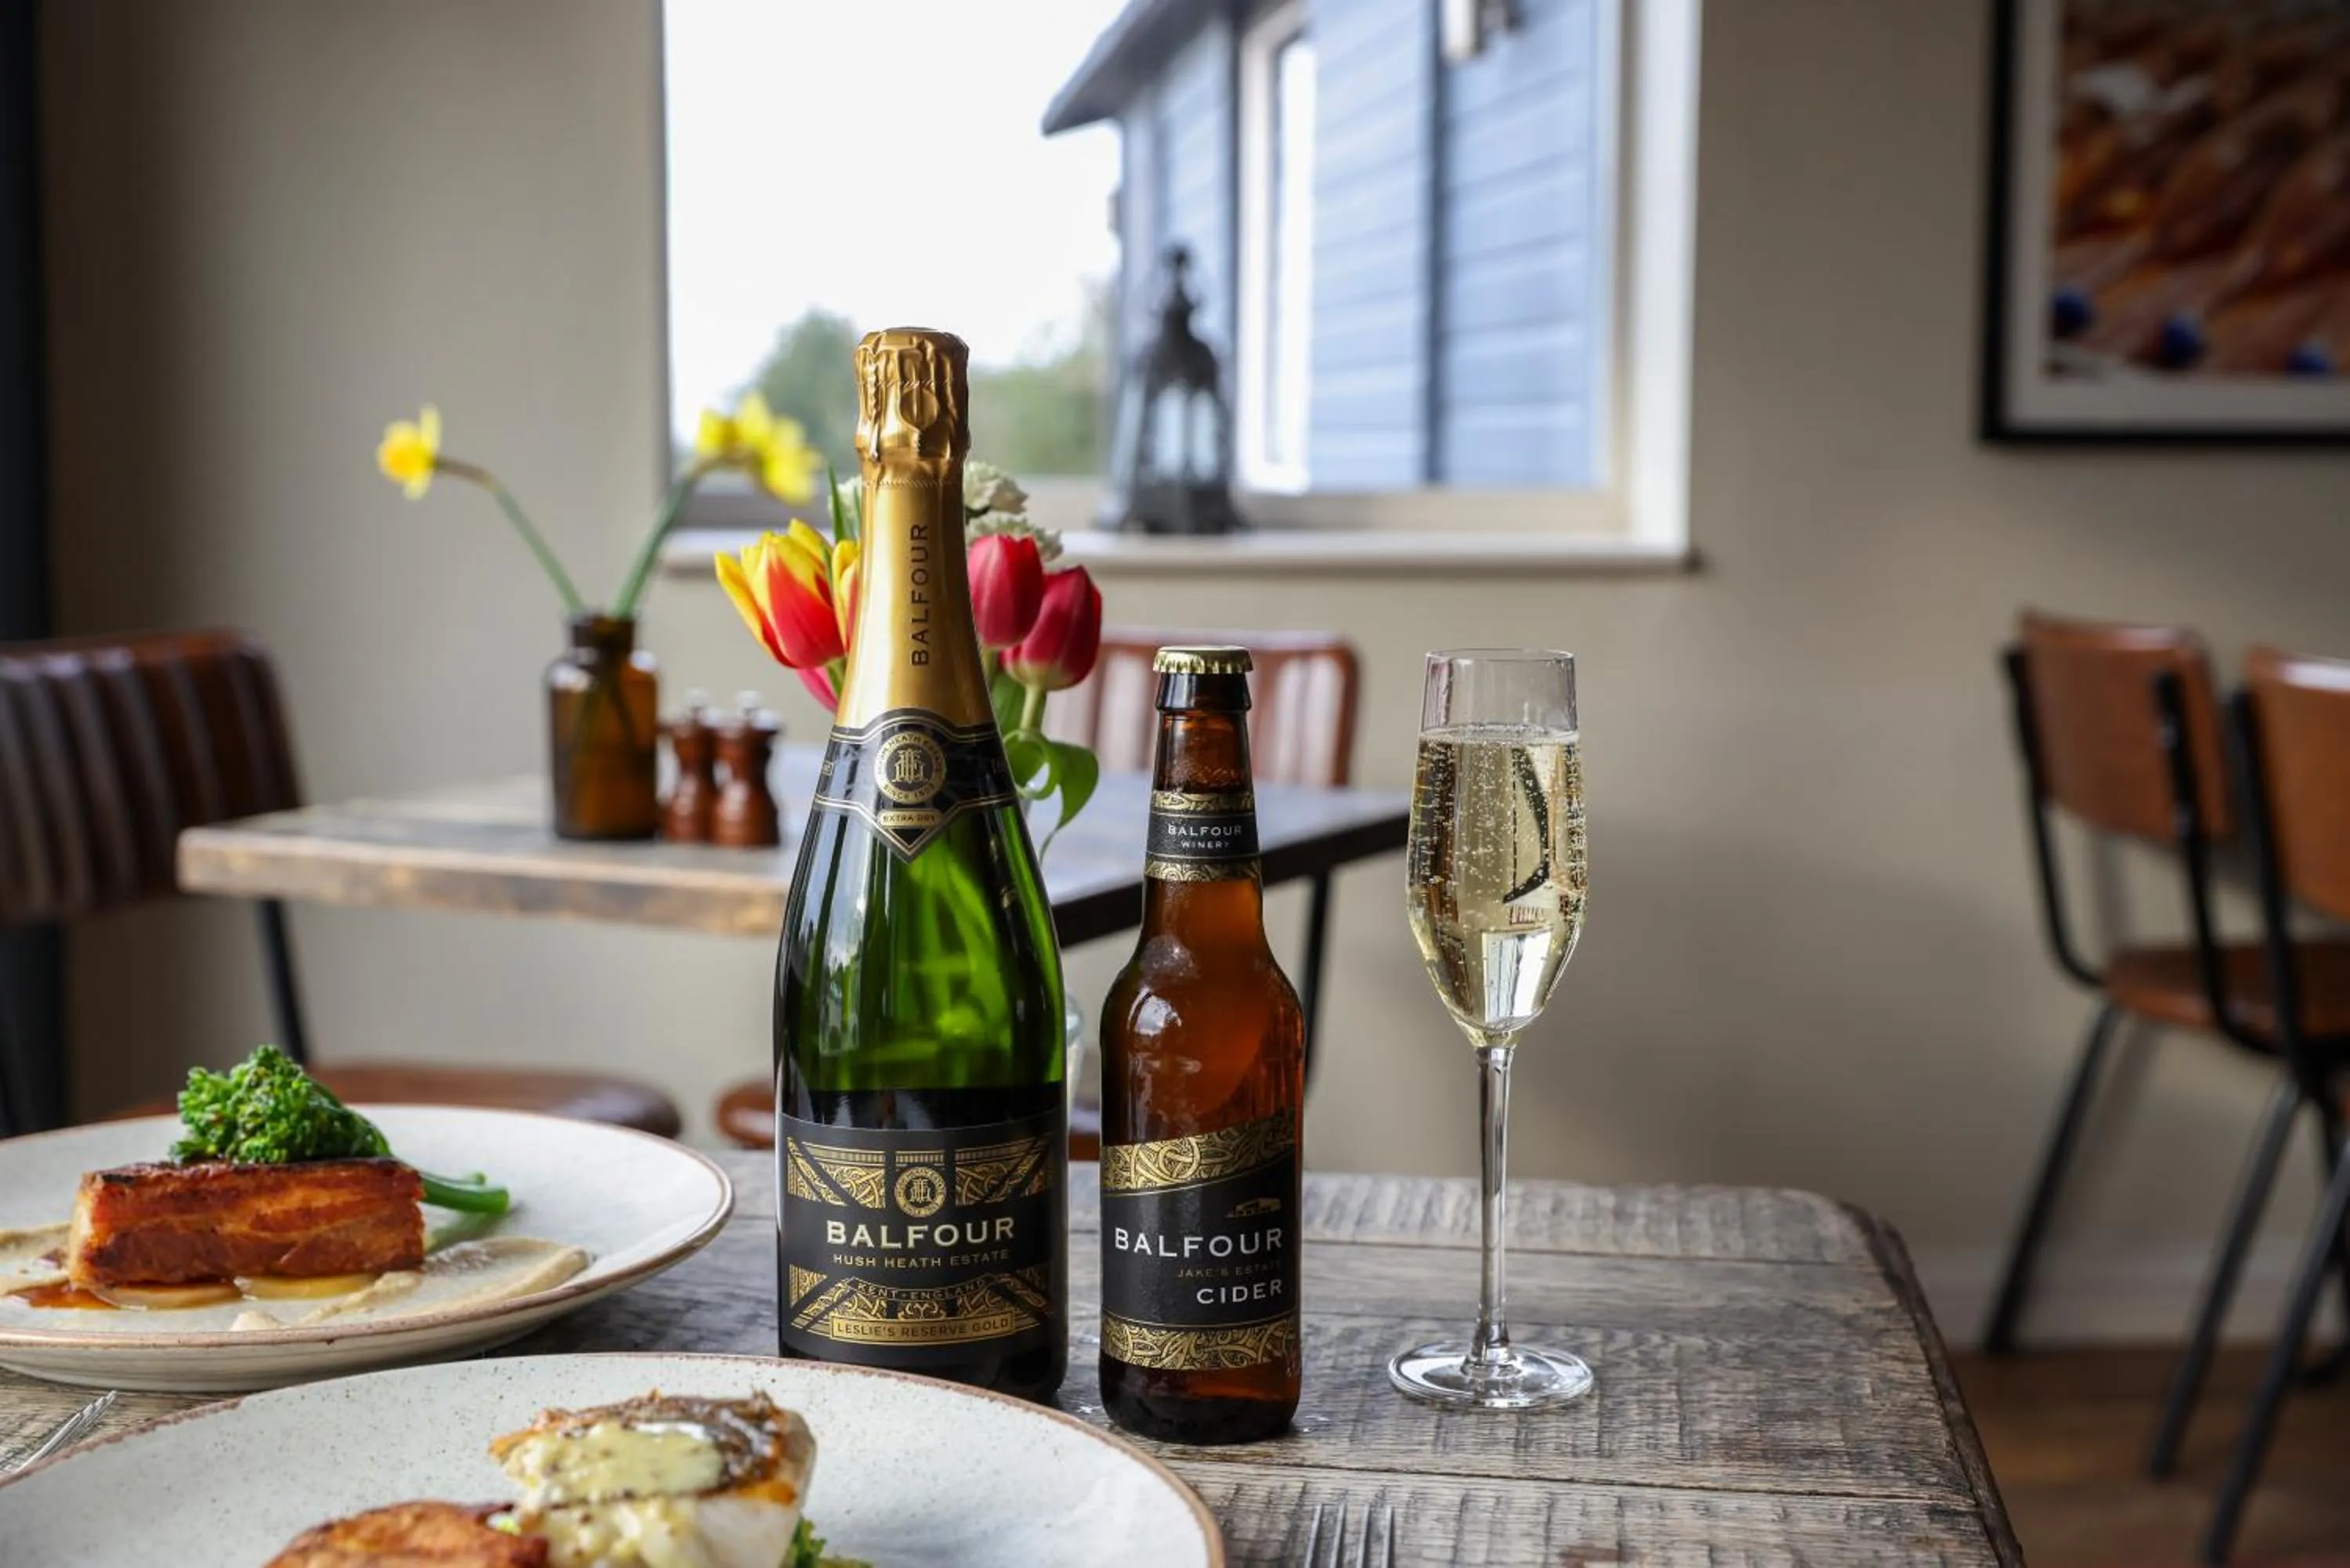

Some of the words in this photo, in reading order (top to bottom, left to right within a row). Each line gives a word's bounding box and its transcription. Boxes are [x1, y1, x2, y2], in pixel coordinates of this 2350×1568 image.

[911, 524, 928, 665] BALFOUR
[916, 815, 936, 823] DRY
[1167, 824, 1242, 836] BALFOUR
[1181, 840, 1230, 849] WINERY
[826, 1217, 1014, 1249] BALFOUR
[1115, 1227, 1282, 1259] BALFOUR
[833, 1253, 877, 1267] HUSH
[884, 1256, 942, 1269] HEATH
[949, 1249, 1010, 1266] ESTATE
[1177, 1266, 1230, 1277] JAKE'S
[857, 1283, 898, 1299] KENT
[910, 1280, 986, 1300] ENGLAND
[1196, 1278, 1282, 1304] CIDER
[837, 1322, 897, 1337] LESLIE'S
[901, 1324, 967, 1337] RESERVE
[972, 1317, 1009, 1332] GOLD
